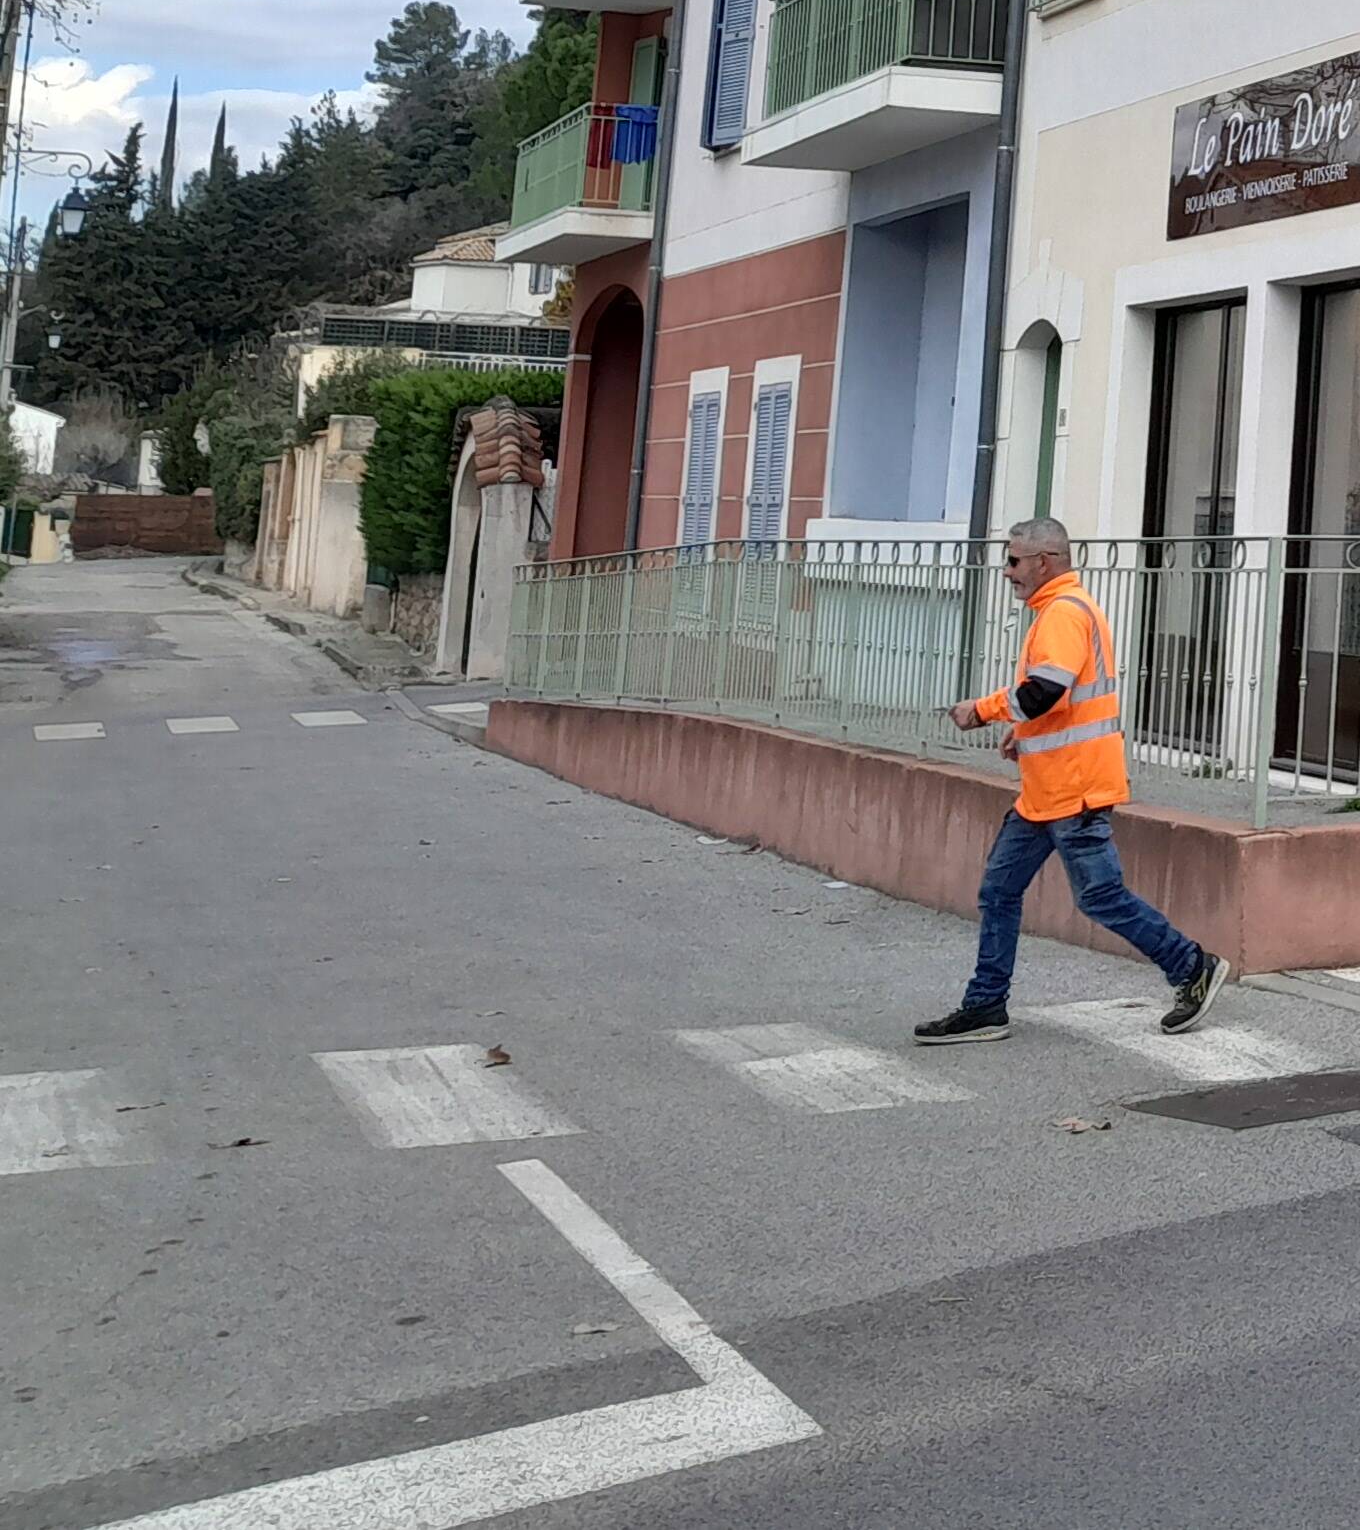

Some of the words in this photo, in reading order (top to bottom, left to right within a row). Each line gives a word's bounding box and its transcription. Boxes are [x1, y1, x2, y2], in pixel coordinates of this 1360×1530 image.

[1187, 116, 1217, 176] Le
[1224, 107, 1280, 167] Pain
[1290, 79, 1357, 150] Doré
[1184, 186, 1238, 215] BOULANGERIE
[1242, 172, 1298, 201] VIENNOISERIE
[1302, 161, 1349, 188] PATISSERIE
